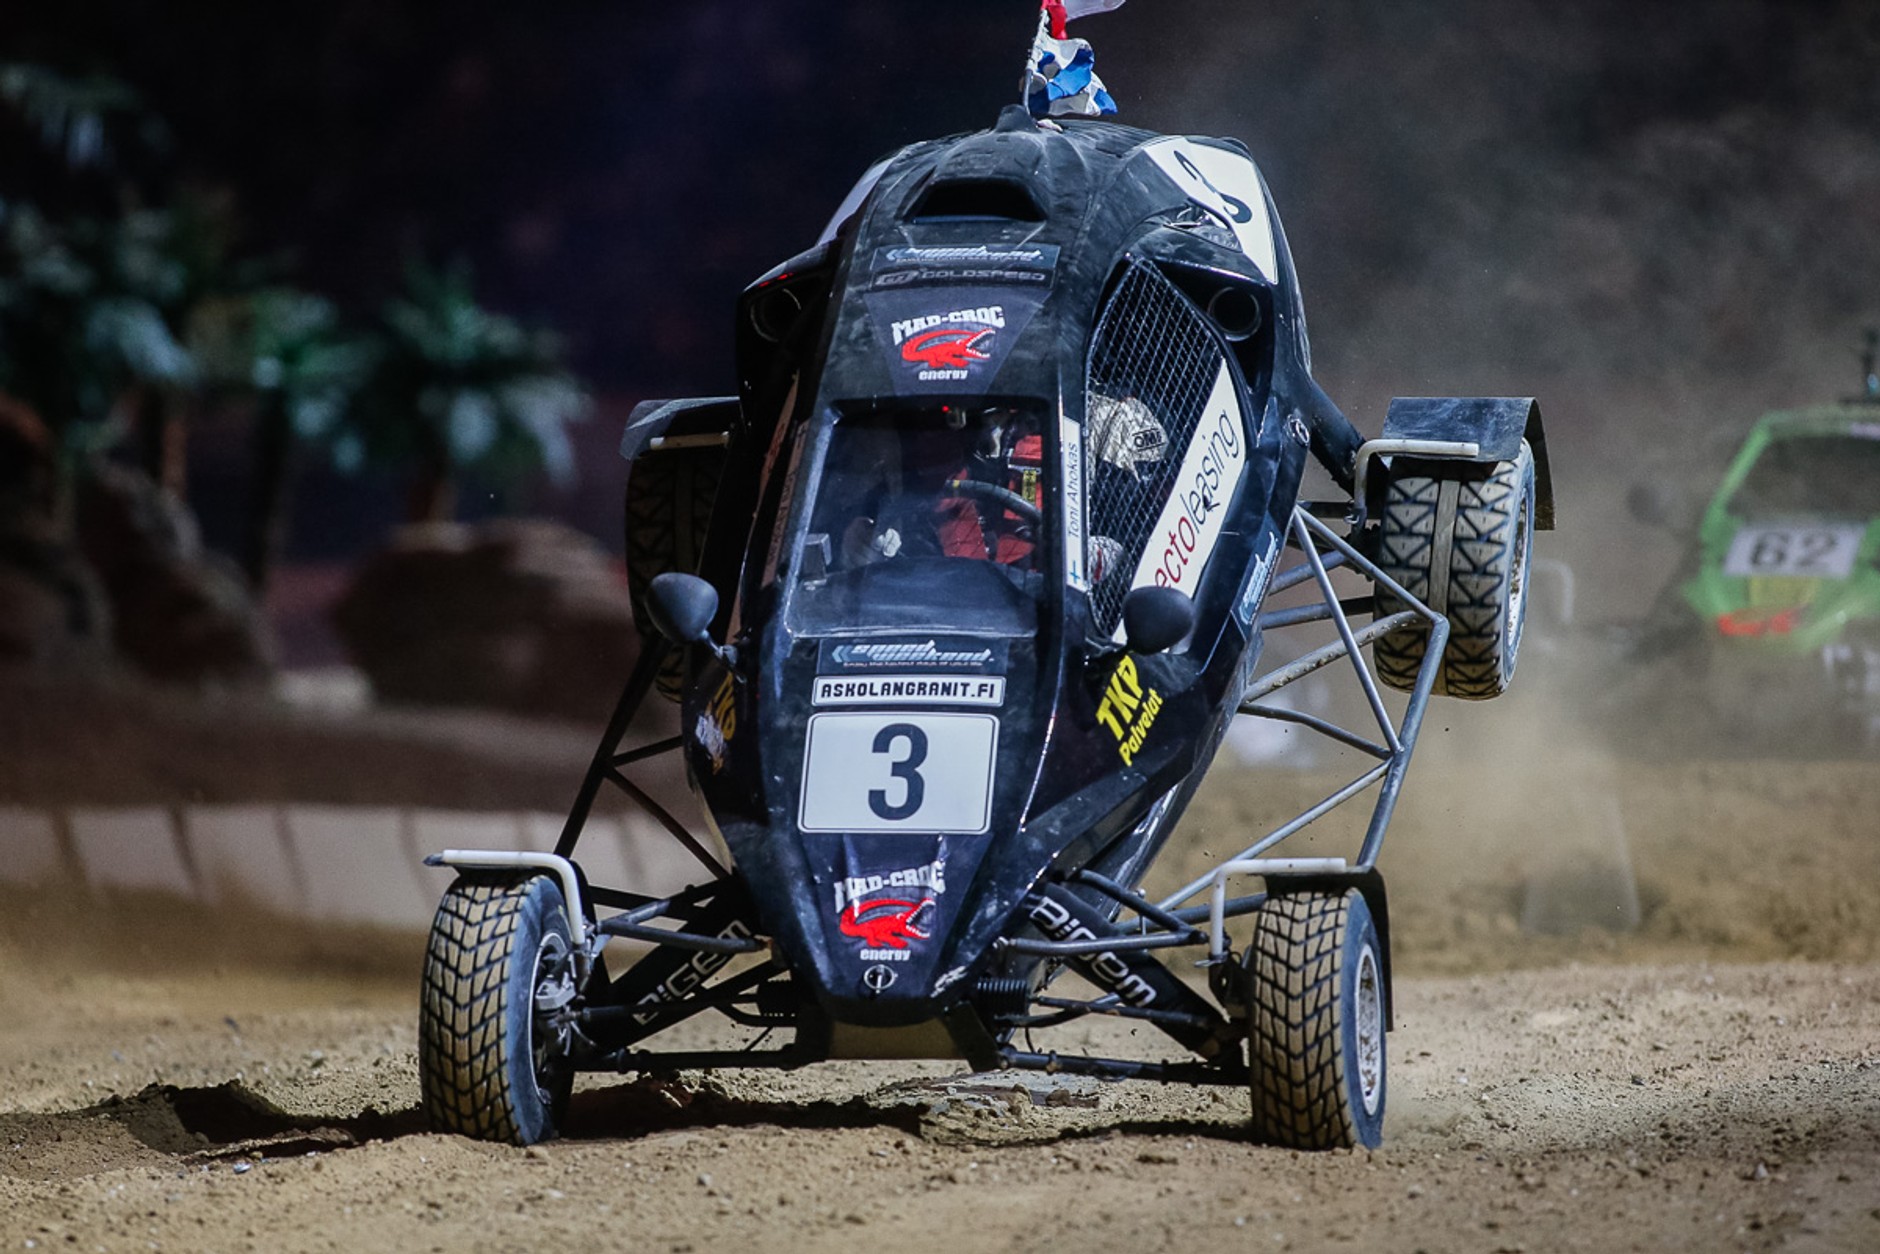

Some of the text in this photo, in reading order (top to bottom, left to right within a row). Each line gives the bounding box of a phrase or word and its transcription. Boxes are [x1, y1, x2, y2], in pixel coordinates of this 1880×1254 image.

[891, 305, 1006, 346] MAD-CROC
[918, 369, 969, 381] energy
[1066, 442, 1080, 539] Toni Ahokas
[1750, 531, 1838, 570] 62
[820, 682, 995, 699] ASKOLANGRANIT.FI
[1095, 654, 1144, 741] TKP
[868, 722, 929, 821] 3
[833, 860, 946, 914] MAD-CROC
[859, 948, 912, 961] energy
